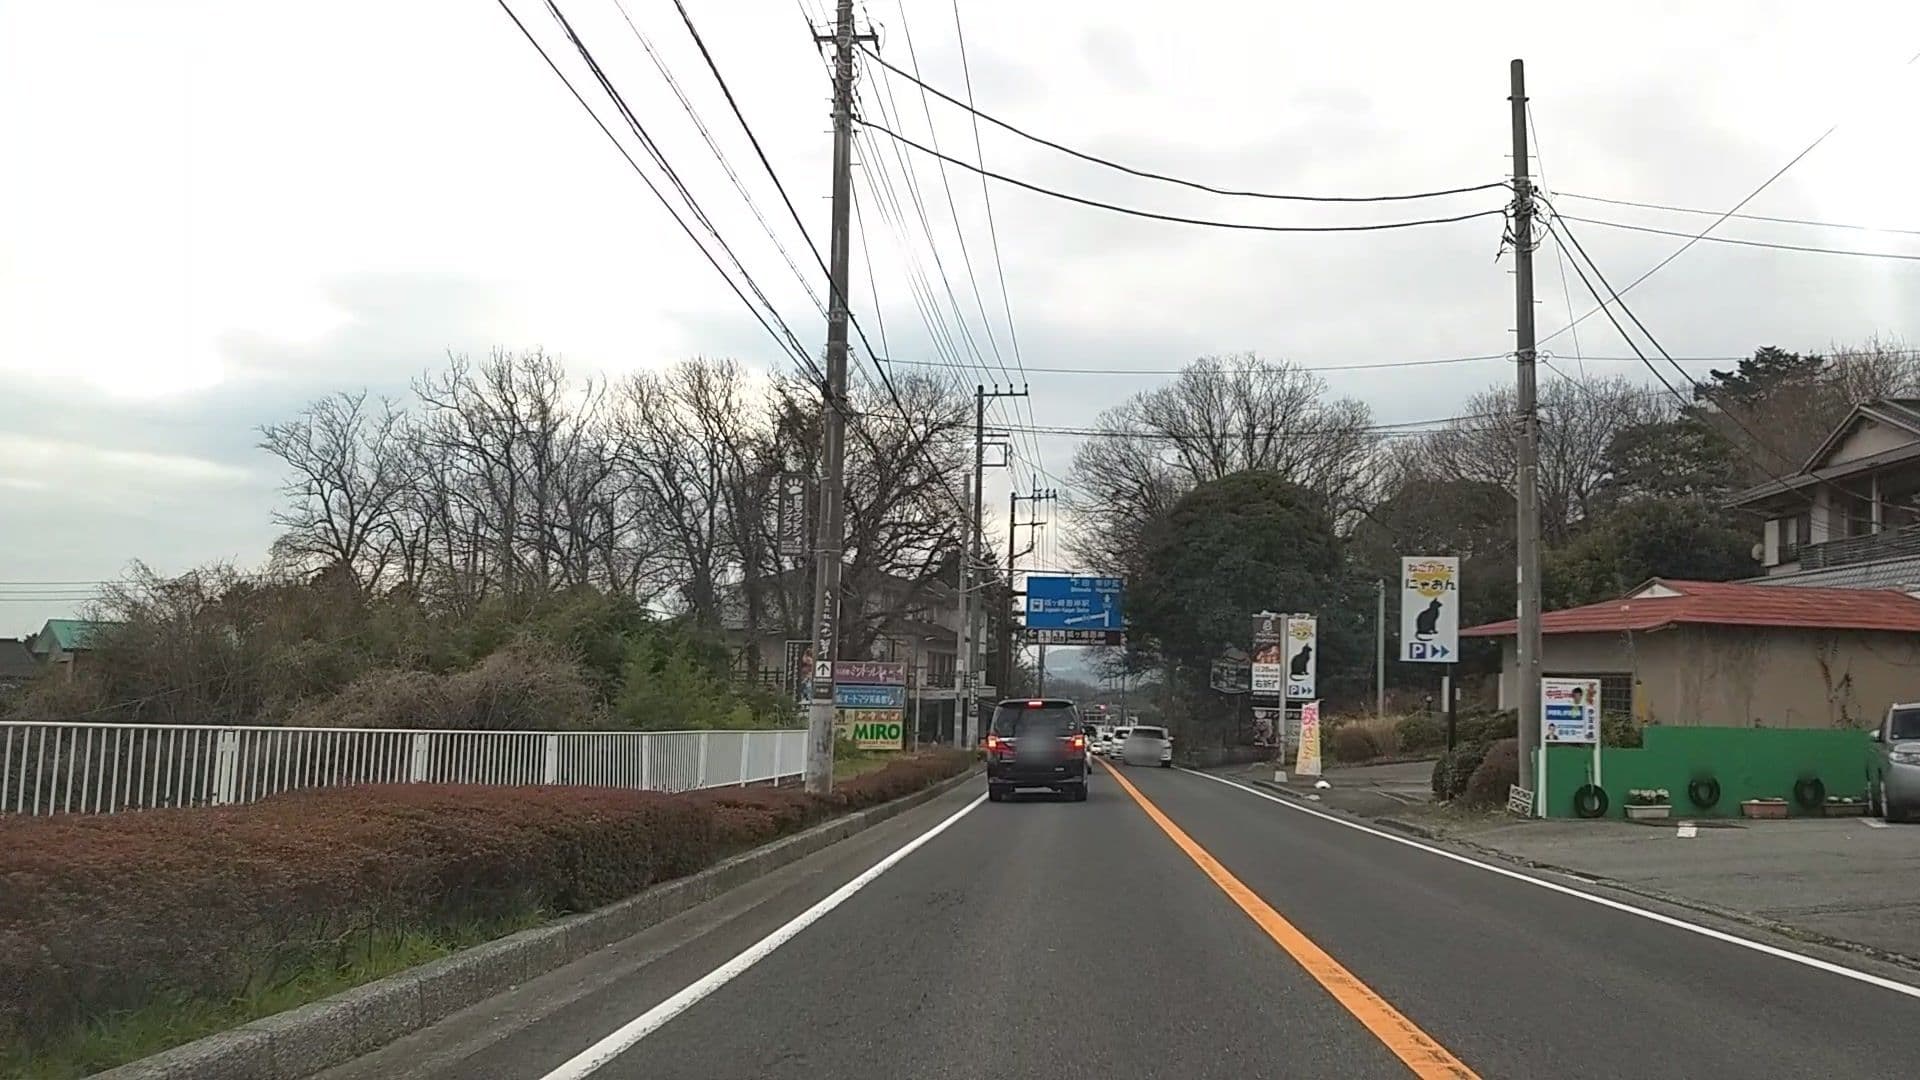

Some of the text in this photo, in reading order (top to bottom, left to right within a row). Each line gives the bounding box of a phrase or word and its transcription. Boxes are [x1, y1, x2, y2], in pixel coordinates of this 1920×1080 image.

[1407, 563, 1455, 573] ねこカフェ
[852, 724, 901, 740] MIRO
